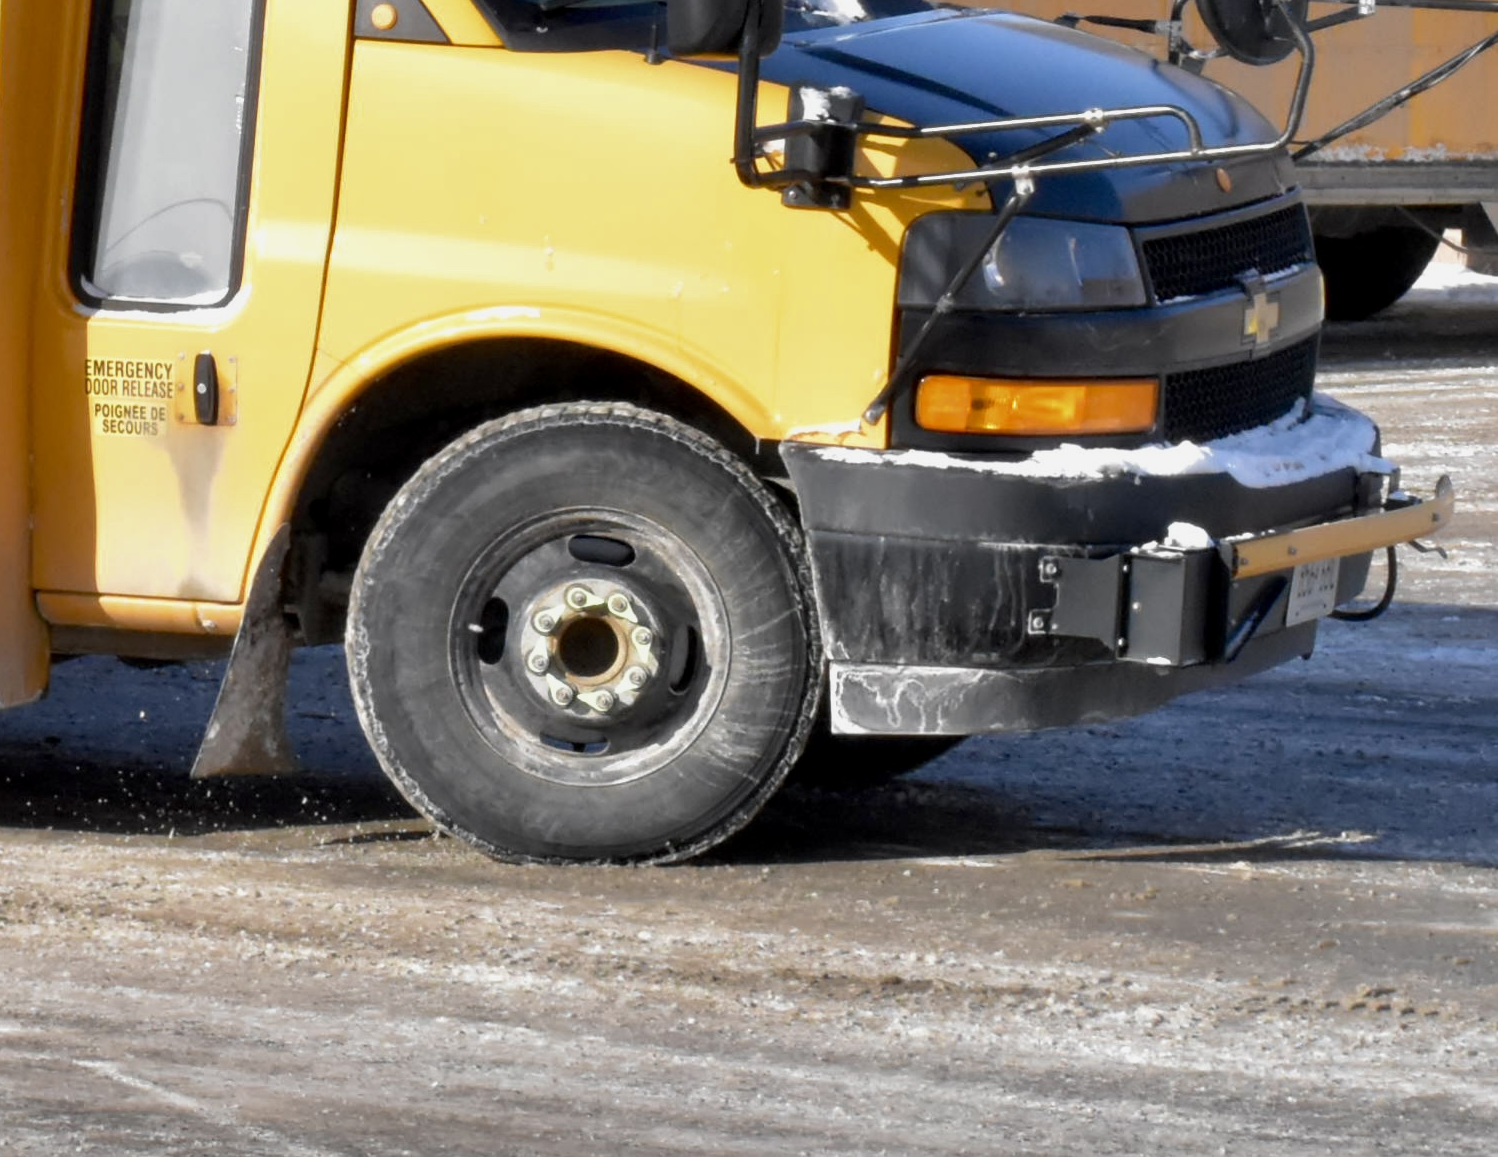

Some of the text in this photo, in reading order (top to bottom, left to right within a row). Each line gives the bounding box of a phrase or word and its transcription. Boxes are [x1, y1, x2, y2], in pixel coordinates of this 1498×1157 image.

[85, 358, 173, 380] EMERGENCY
[85, 377, 173, 399] DOOR RELEASE
[151, 406, 166, 422] DE
[102, 418, 158, 436] SECOURS
